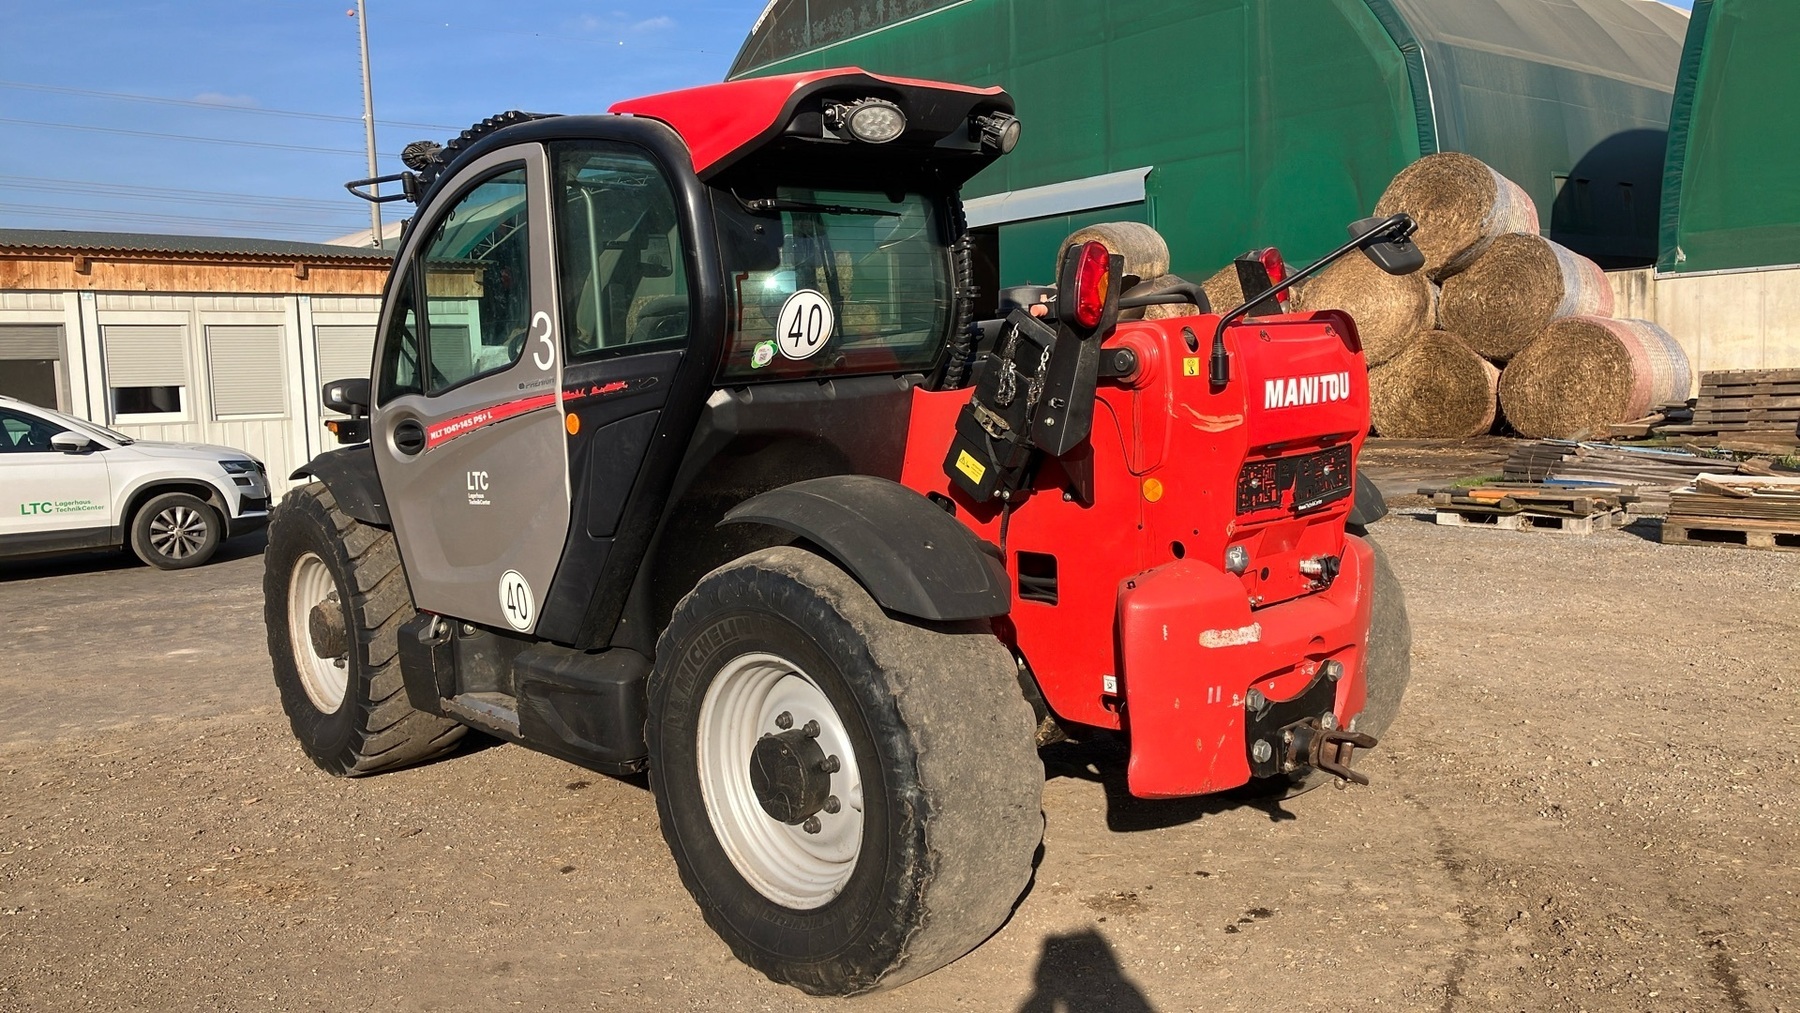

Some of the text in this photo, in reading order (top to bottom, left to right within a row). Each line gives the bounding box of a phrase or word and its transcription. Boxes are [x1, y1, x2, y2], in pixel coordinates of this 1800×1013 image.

[532, 310, 555, 371] 3
[787, 304, 823, 347] 40
[1265, 372, 1349, 409] MANITOU
[487, 411, 493, 419] L
[467, 471, 489, 491] LTC
[20, 502, 53, 515] LTC
[55, 505, 105, 513] TechnikCenter
[507, 581, 528, 620] 40
[674, 617, 752, 695] MICHELIN
